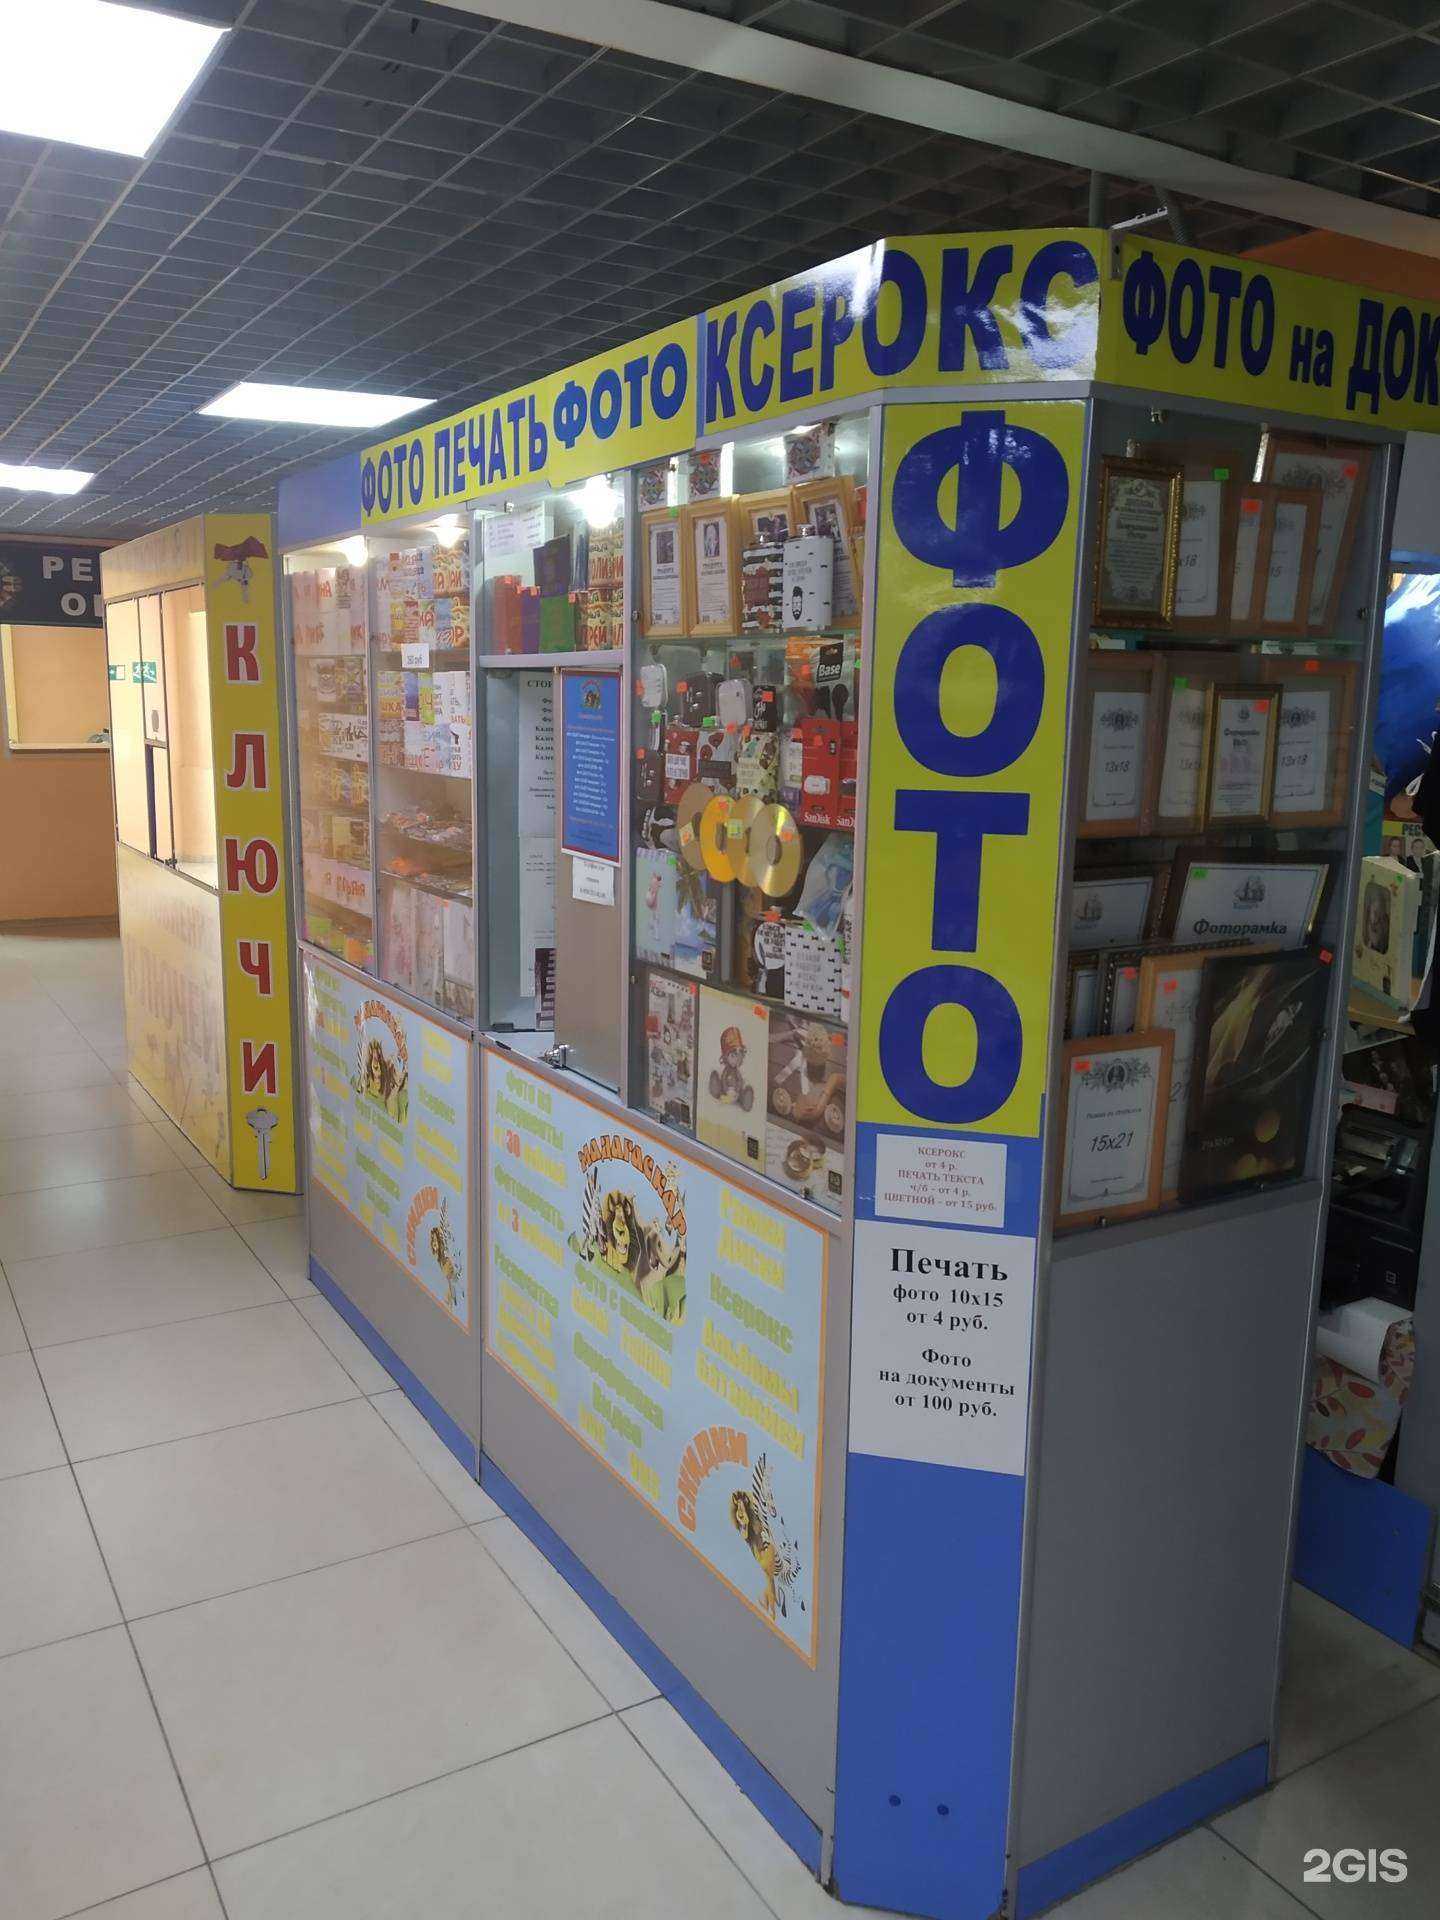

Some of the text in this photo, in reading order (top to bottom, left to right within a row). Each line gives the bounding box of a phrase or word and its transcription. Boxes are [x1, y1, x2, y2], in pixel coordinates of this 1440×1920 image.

[1122, 250, 1276, 377] ФОТО
[1289, 324, 1335, 388] на
[706, 240, 1099, 423] КСЕРОКС
[552, 342, 688, 450] ФОТО
[361, 393, 548, 519] ФОТО ПЕЧАТЬ
[818, 664, 841, 678] Base
[880, 409, 1070, 1124] ФОТО
[804, 810, 832, 826] SanDisk
[224, 622, 280, 1096] КЛЮЧИ
[1193, 918, 1288, 936] Фоторамка
[917, 1147, 966, 1159] КСЕРОКС
[897, 1169, 985, 1186] ПЕЧАТЬ ТЕКСТА
[925, 1161, 938, 1171] от
[939, 1161, 946, 1171] 4
[578, 1134, 687, 1236] МАДАГАСКАР
[937, 1186, 950, 1196] от
[950, 1186, 959, 1197] 4
[884, 1191, 935, 1207] ЦВЕТНОЙ
[945, 1198, 958, 1208] от
[961, 1199, 974, 1210] 15
[975, 1201, 998, 1213] руб.
[889, 1247, 1009, 1282] Печать
[892, 1283, 940, 1304] фото
[710, 1271, 794, 1354] Ксерокс
[906, 1310, 988, 1333] от 4 руб.
[921, 1348, 972, 1368] Фото
[878, 1369, 1016, 1398] на документы
[894, 1394, 998, 1419] от 100 руб.
